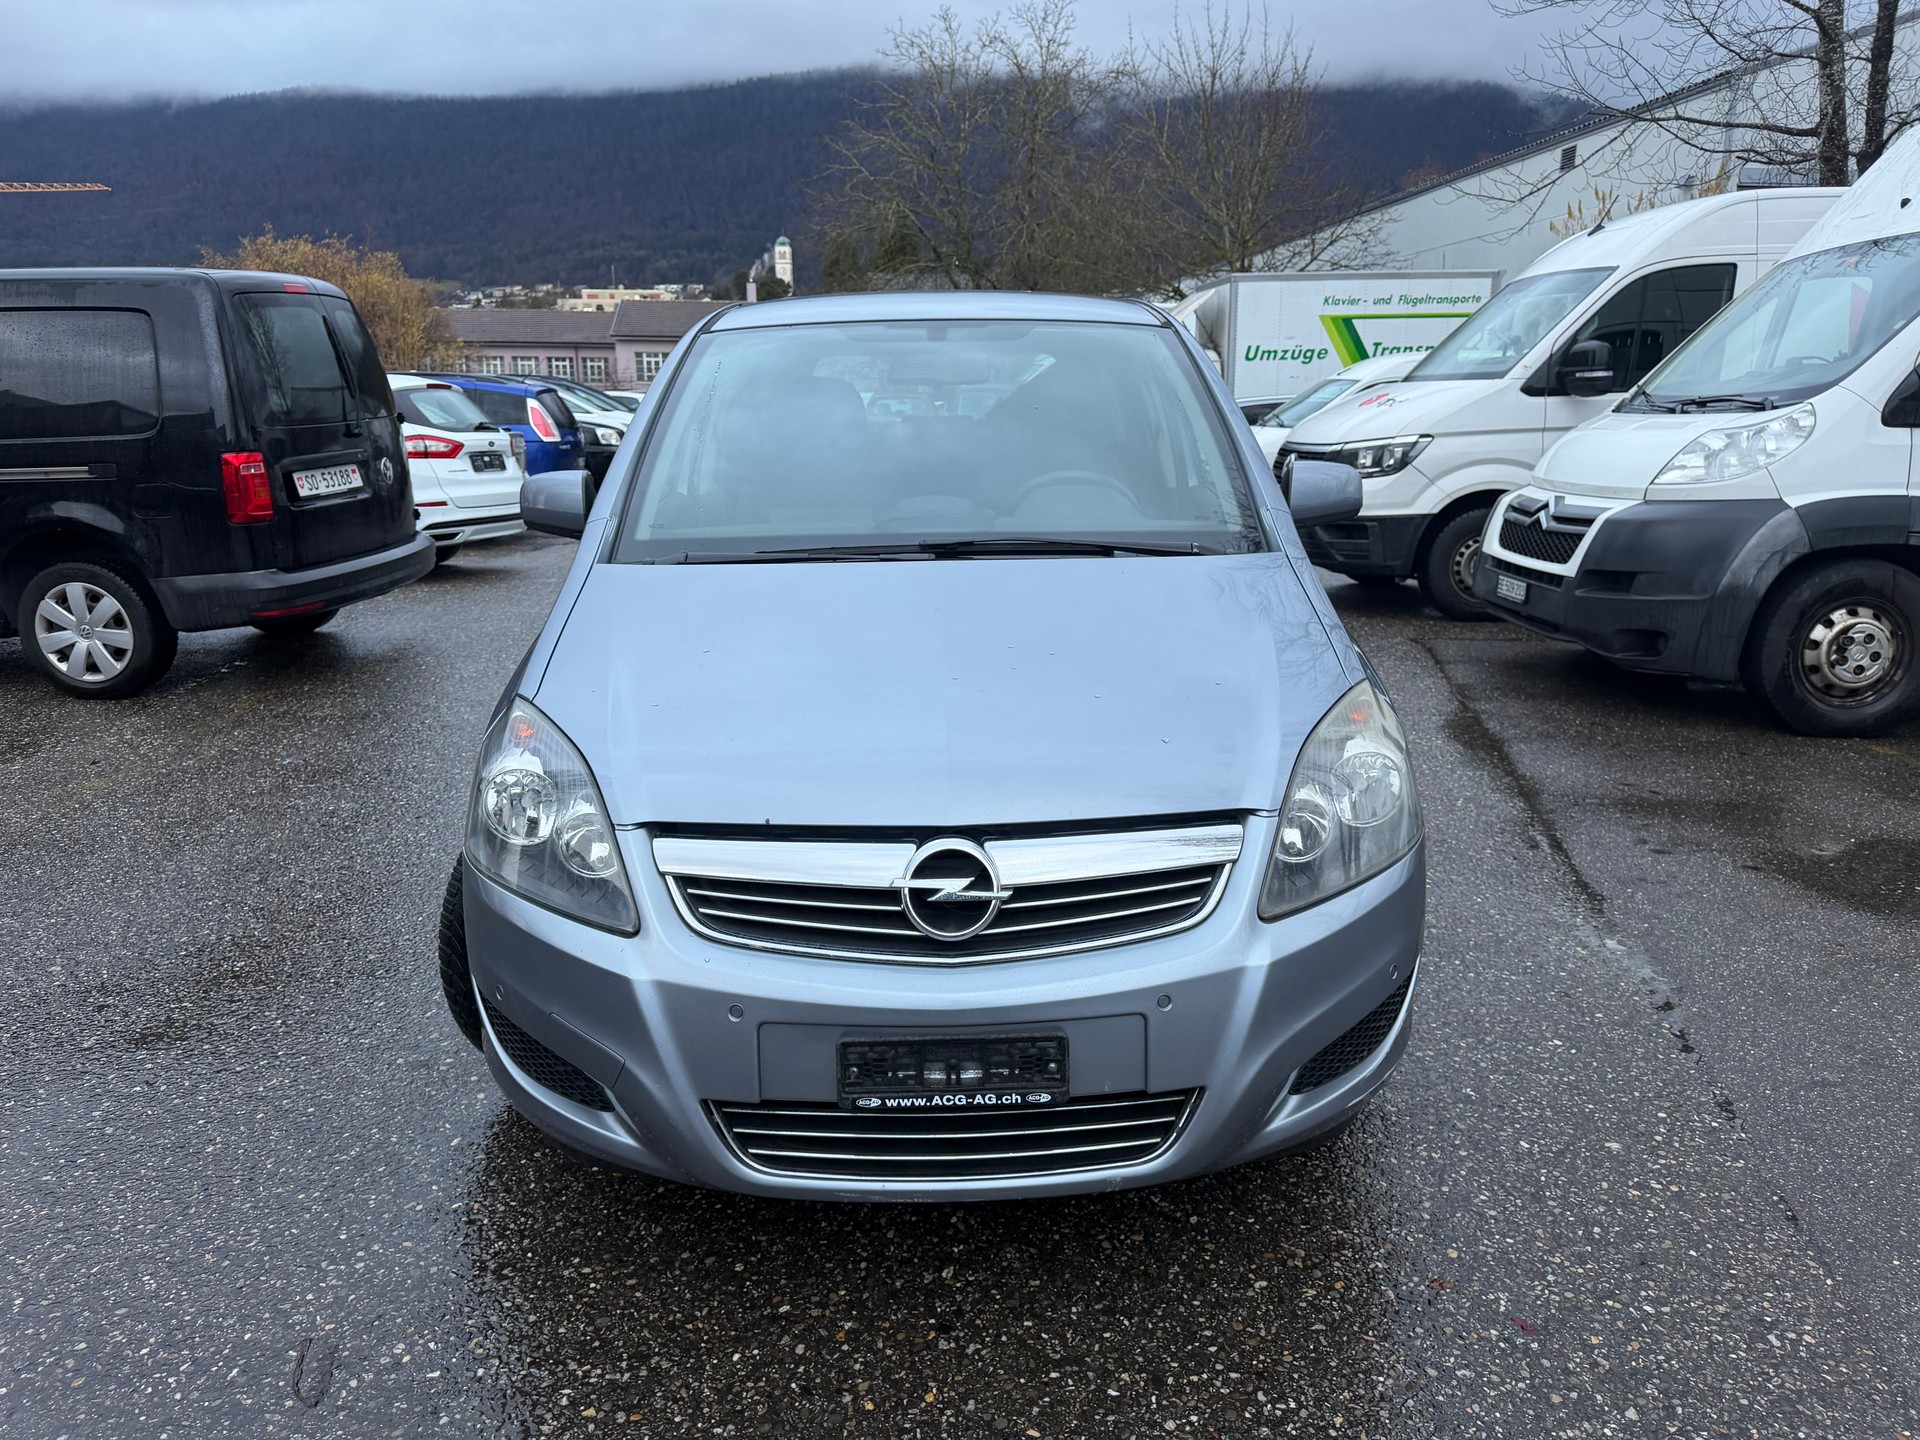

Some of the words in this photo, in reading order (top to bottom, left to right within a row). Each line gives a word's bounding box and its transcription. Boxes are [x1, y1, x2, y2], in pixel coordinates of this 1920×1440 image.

[1323, 295, 1367, 306] Klavier-
[1373, 295, 1393, 305] und
[1398, 293, 1482, 307] Flügeltransporte
[1244, 344, 1328, 364] Umzüge
[885, 1093, 1022, 1107] www.ACG-AG.ch
